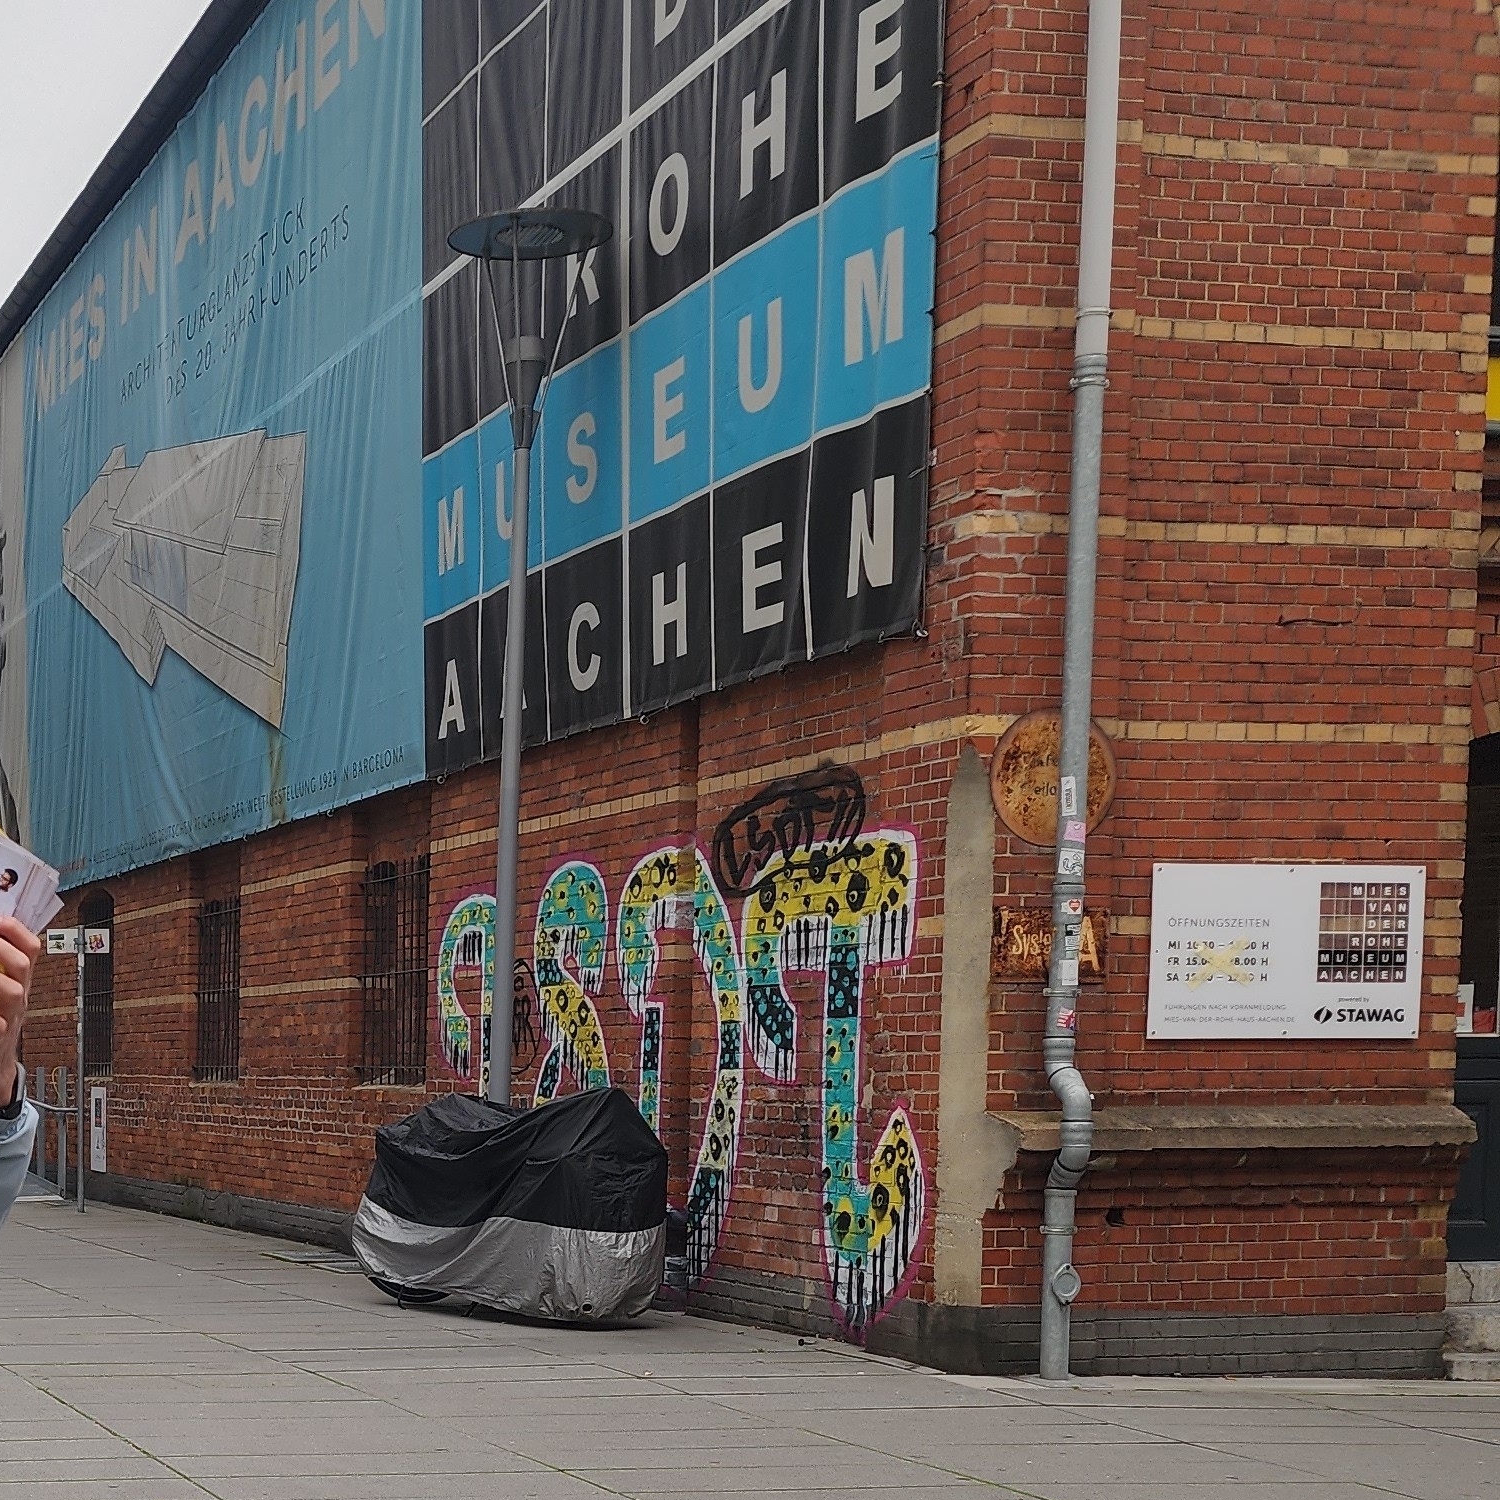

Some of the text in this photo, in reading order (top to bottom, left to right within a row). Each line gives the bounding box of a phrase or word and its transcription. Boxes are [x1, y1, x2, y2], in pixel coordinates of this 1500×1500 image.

[166, 204, 350, 404] DES 20. JAHRHUNDERTS
[36, 273, 106, 422] MIES
[121, 204, 158, 327] IN
[437, 475, 895, 740] ACHEN
[231, 801, 245, 820] DER
[319, 769, 337, 790] 1929
[352, 745, 405, 779] BARCELONA
[1352, 886, 1407, 896] MIES
[1368, 902, 1407, 913] VAN
[1168, 917, 1270, 928] ÖFFNUNGSZEITEN
[1368, 919, 1406, 929] DER
[1167, 941, 1181, 950] MI
[1261, 941, 1270, 950] H
[1352, 937, 1405, 947] ROHE
[1167, 957, 1180, 966] FR
[1260, 957, 1269, 966] H
[1320, 953, 1405, 963] MUSEUM
[1166, 973, 1180, 982] SA
[1260, 973, 1268, 982] H
[1319, 970, 1404, 980] AACHEN
[1336, 1008, 1405, 1023] STAWAG
